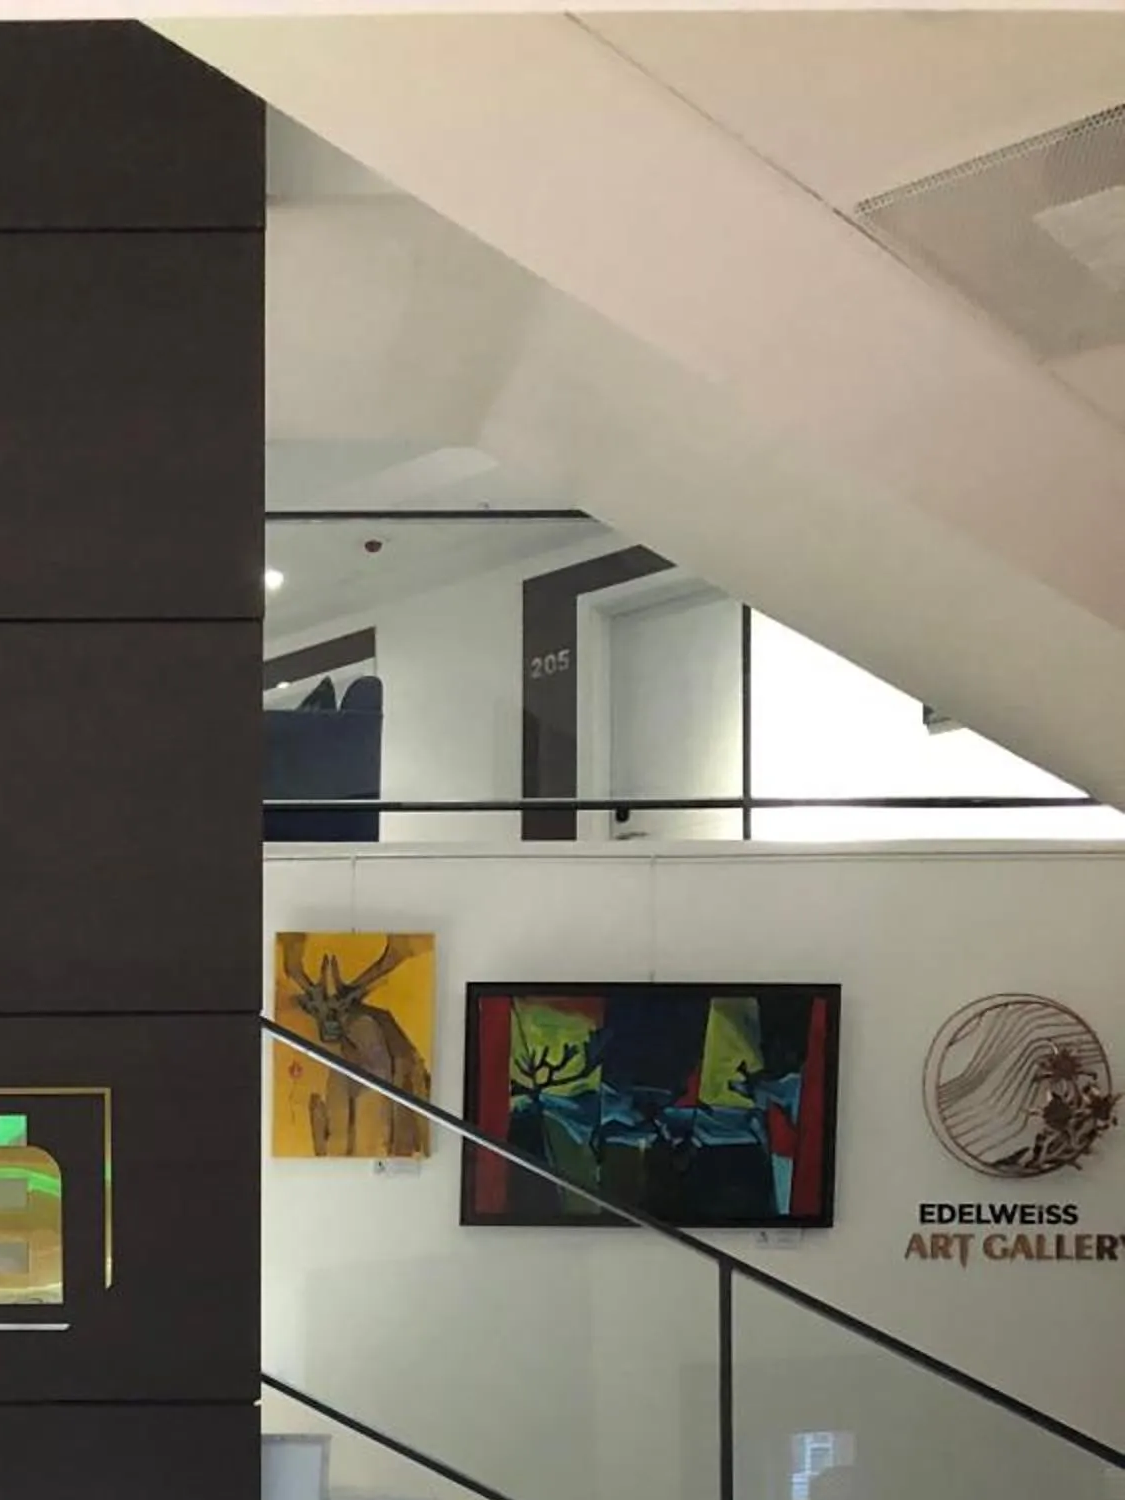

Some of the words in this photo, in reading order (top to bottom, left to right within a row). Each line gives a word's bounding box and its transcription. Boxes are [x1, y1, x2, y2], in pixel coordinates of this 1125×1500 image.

[531, 649, 570, 679] 205
[904, 1233, 974, 1269] ART
[982, 1233, 1125, 1262] GALLER
